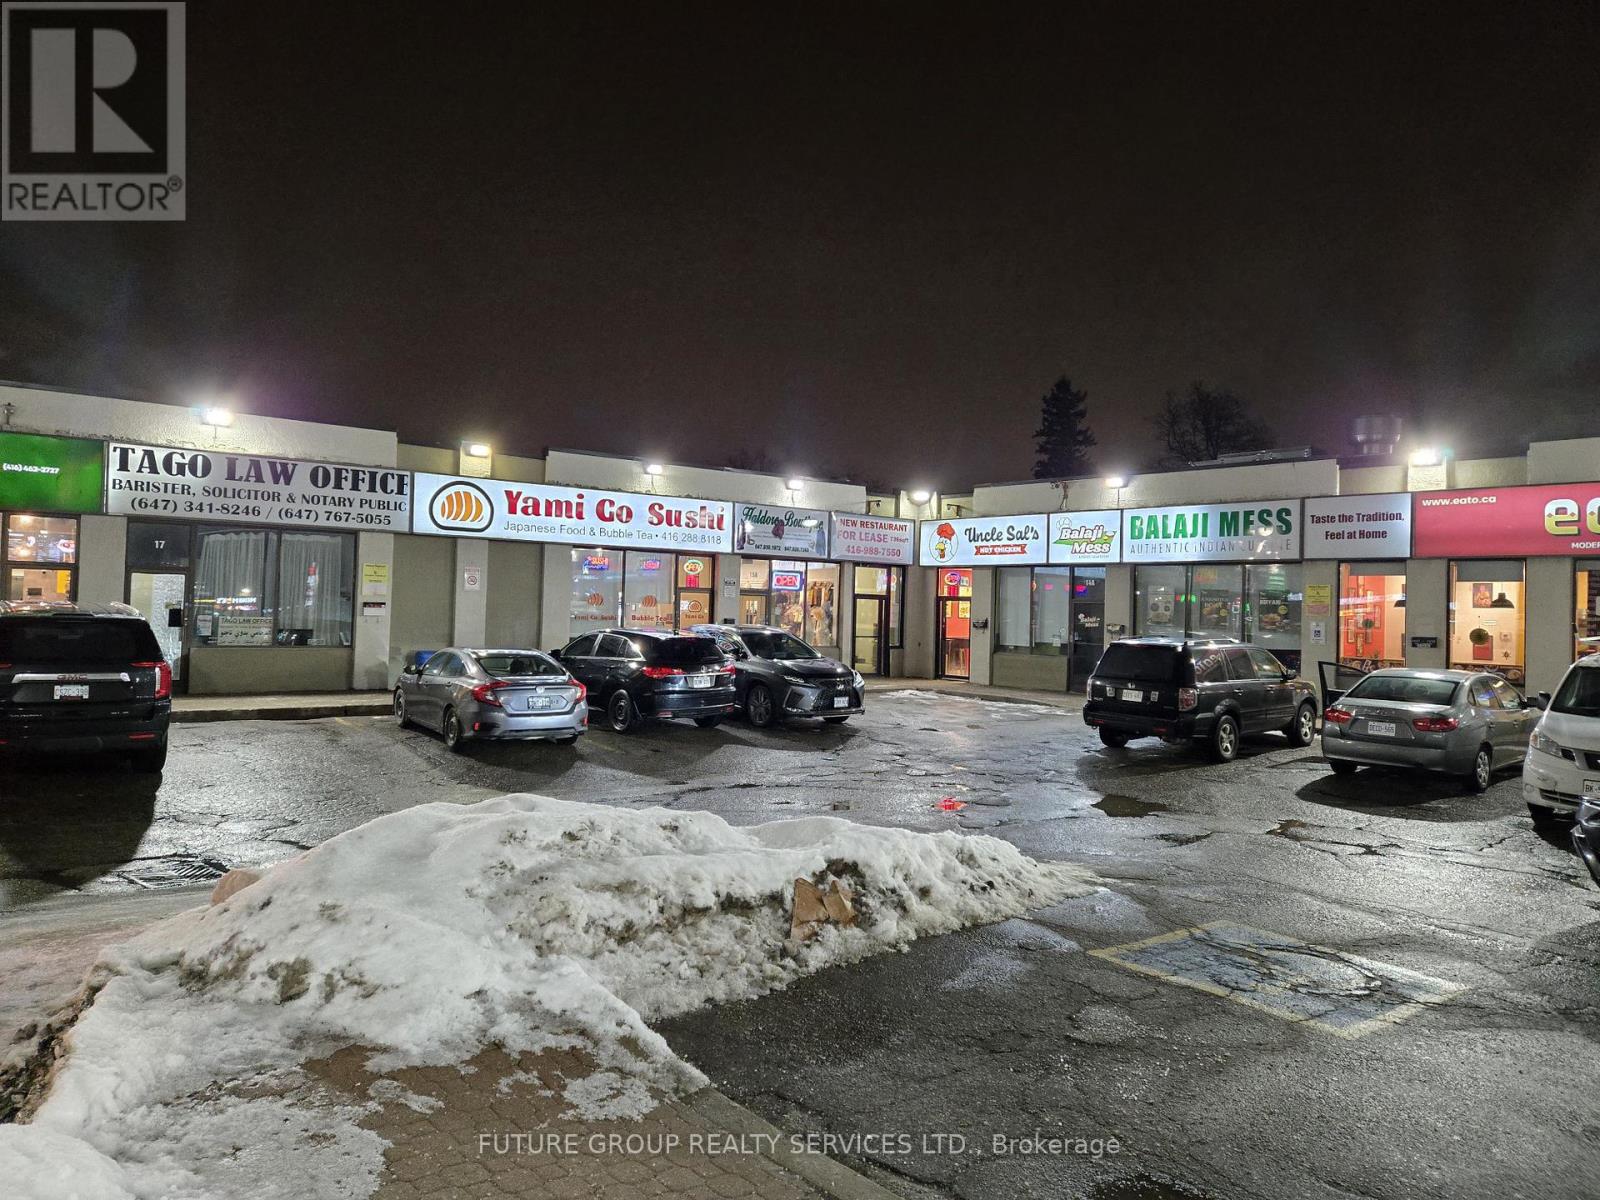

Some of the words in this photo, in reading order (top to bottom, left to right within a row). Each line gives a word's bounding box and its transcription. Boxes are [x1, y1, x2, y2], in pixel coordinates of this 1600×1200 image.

[112, 446, 212, 478] TAGO
[225, 456, 298, 486] LAW
[309, 465, 409, 496] OFFICE
[112, 478, 196, 497] BARISTER,
[202, 486, 281, 503] SOLICITOR
[286, 492, 297, 504] &
[301, 494, 355, 509] NOTARY
[360, 498, 407, 512] PUBLIC
[1422, 495, 1497, 507] www.eato.ca
[131, 497, 178, 514] (647)
[183, 500, 261, 517] 341-8246
[278, 507, 319, 523] (647)
[325, 510, 392, 526] 767-5055
[504, 490, 585, 520] Yami
[648, 502, 726, 531] Sushi
[1310, 513, 1336, 524] Taste
[1338, 512, 1354, 523] the
[1356, 511, 1405, 523] Tradition,
[503, 521, 556, 535] Japanese
[559, 525, 586, 536] Food
[589, 527, 597, 536] &
[599, 528, 633, 540] Bubble
[636, 530, 653, 540] Tea
[840, 518, 858, 528] NEW
[860, 520, 908, 532] RESTAURANT
[1130, 512, 1209, 540] BALAJI
[1219, 508, 1293, 537] MESS
[837, 530, 856, 541] FOR
[860, 532, 888, 543] LEASE
[964, 526, 1004, 543] Uncle
[1006, 524, 1040, 541] Sal's
[1059, 524, 1104, 541] Balaji
[1325, 530, 1345, 540] Feel
[1347, 530, 1357, 540] at
[1358, 529, 1388, 540] Home
[155, 540, 165, 549] 17
[1070, 542, 1111, 555] Mess
[1130, 541, 1189, 554] AUTHENTIC
[1194, 540, 1235, 552] INDIAN
[775, 575, 798, 586] OPEN
